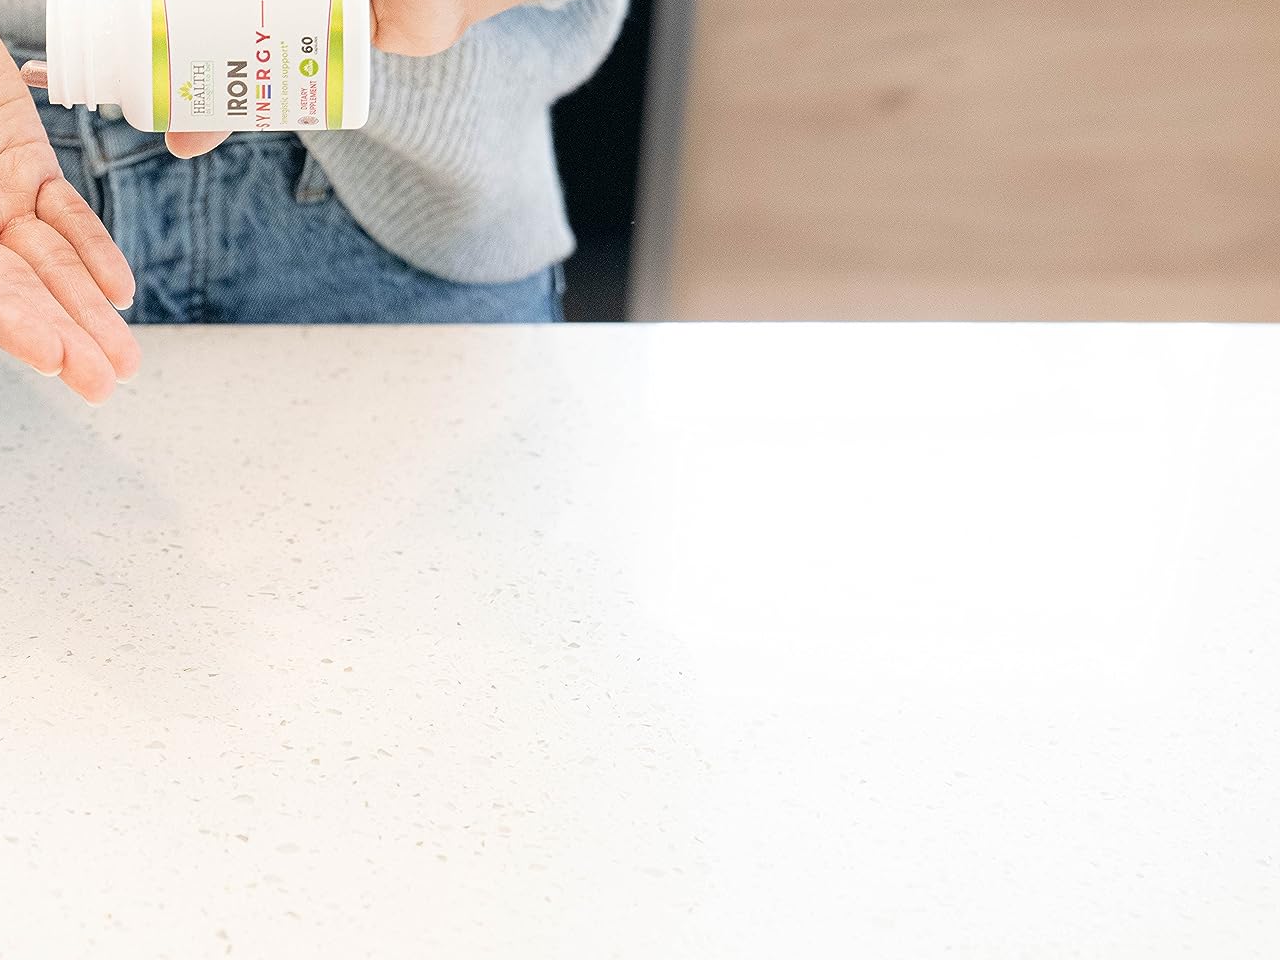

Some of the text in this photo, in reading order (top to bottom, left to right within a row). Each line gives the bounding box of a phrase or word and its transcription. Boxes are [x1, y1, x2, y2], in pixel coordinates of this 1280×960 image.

[301, 36, 313, 54] 60
[193, 65, 206, 114] HEALTH
[227, 60, 248, 116] IRON
[255, 31, 271, 128] SYNERGY
[280, 80, 289, 96] iron
[300, 87, 308, 110] DIETARY
[309, 80, 317, 115] SUPPLEMENT
